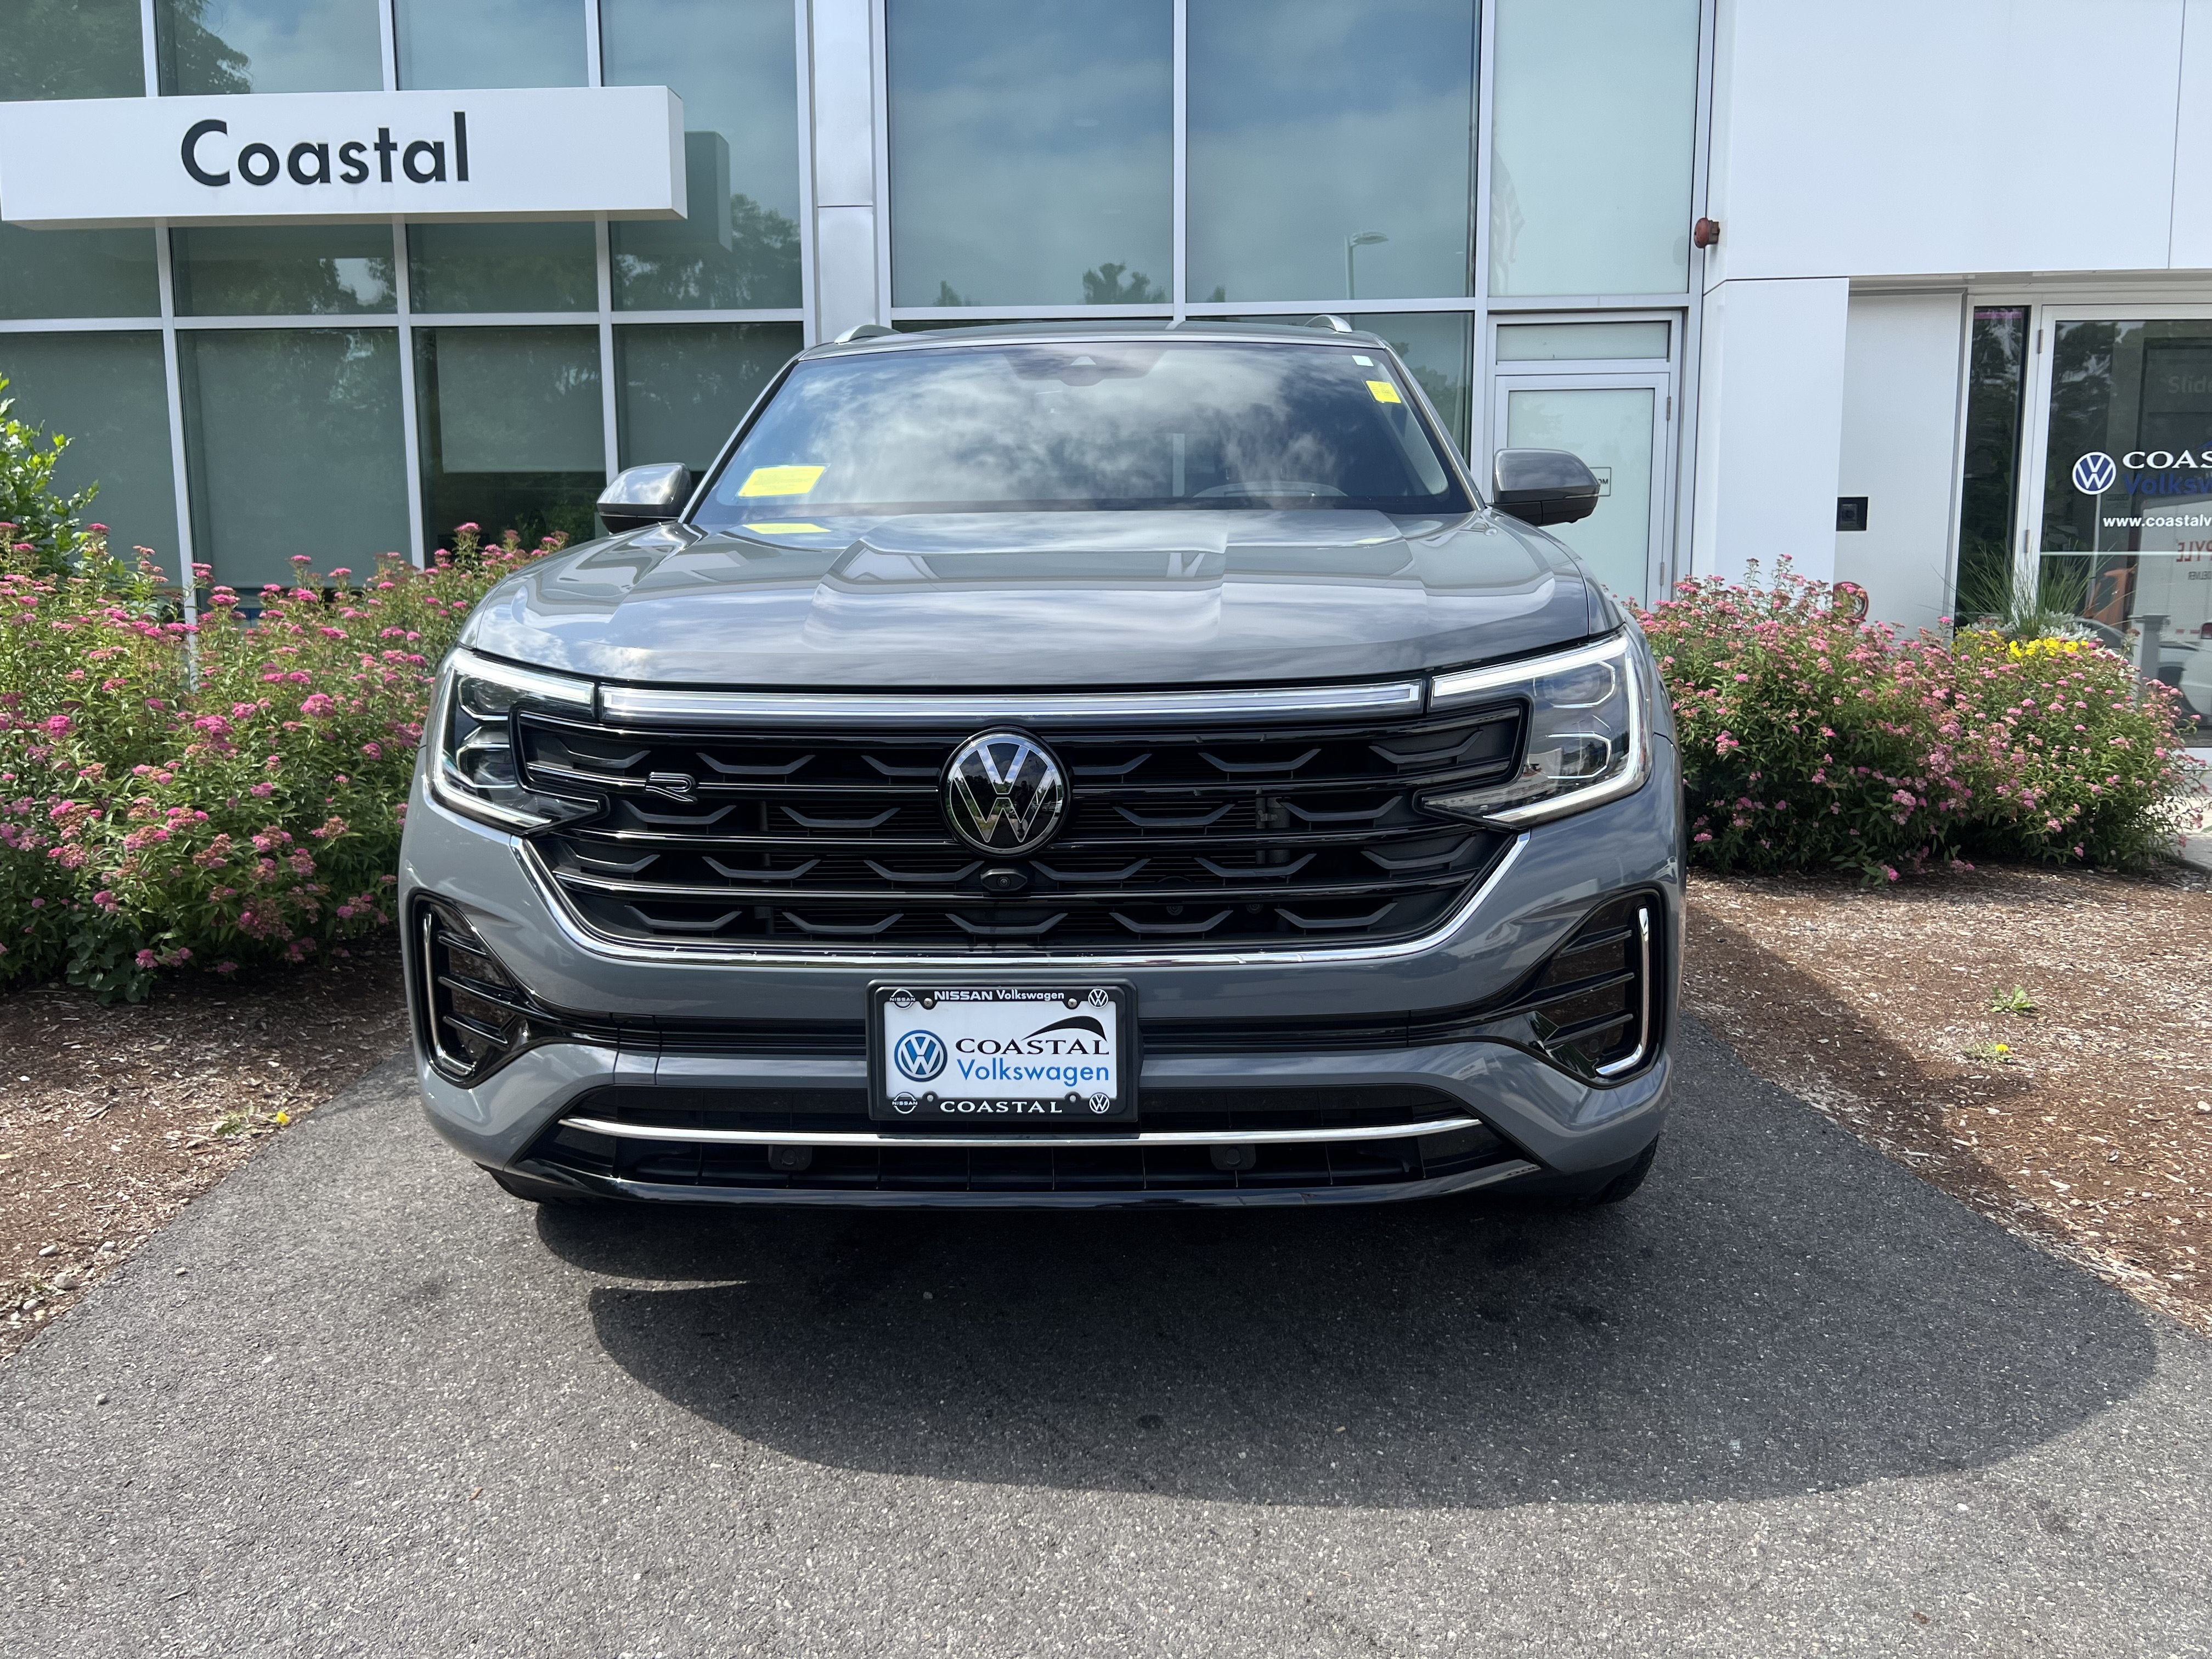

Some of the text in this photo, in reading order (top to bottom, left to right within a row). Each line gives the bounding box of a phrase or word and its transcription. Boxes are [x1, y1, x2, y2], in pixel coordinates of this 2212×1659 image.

[181, 111, 469, 186] Coastal
[934, 990, 1065, 1001] NISSAN Volkswagen
[955, 1038, 1109, 1055] COASTAL
[956, 1058, 1109, 1087] Volkswagen
[940, 1101, 1063, 1113] COASTAL
